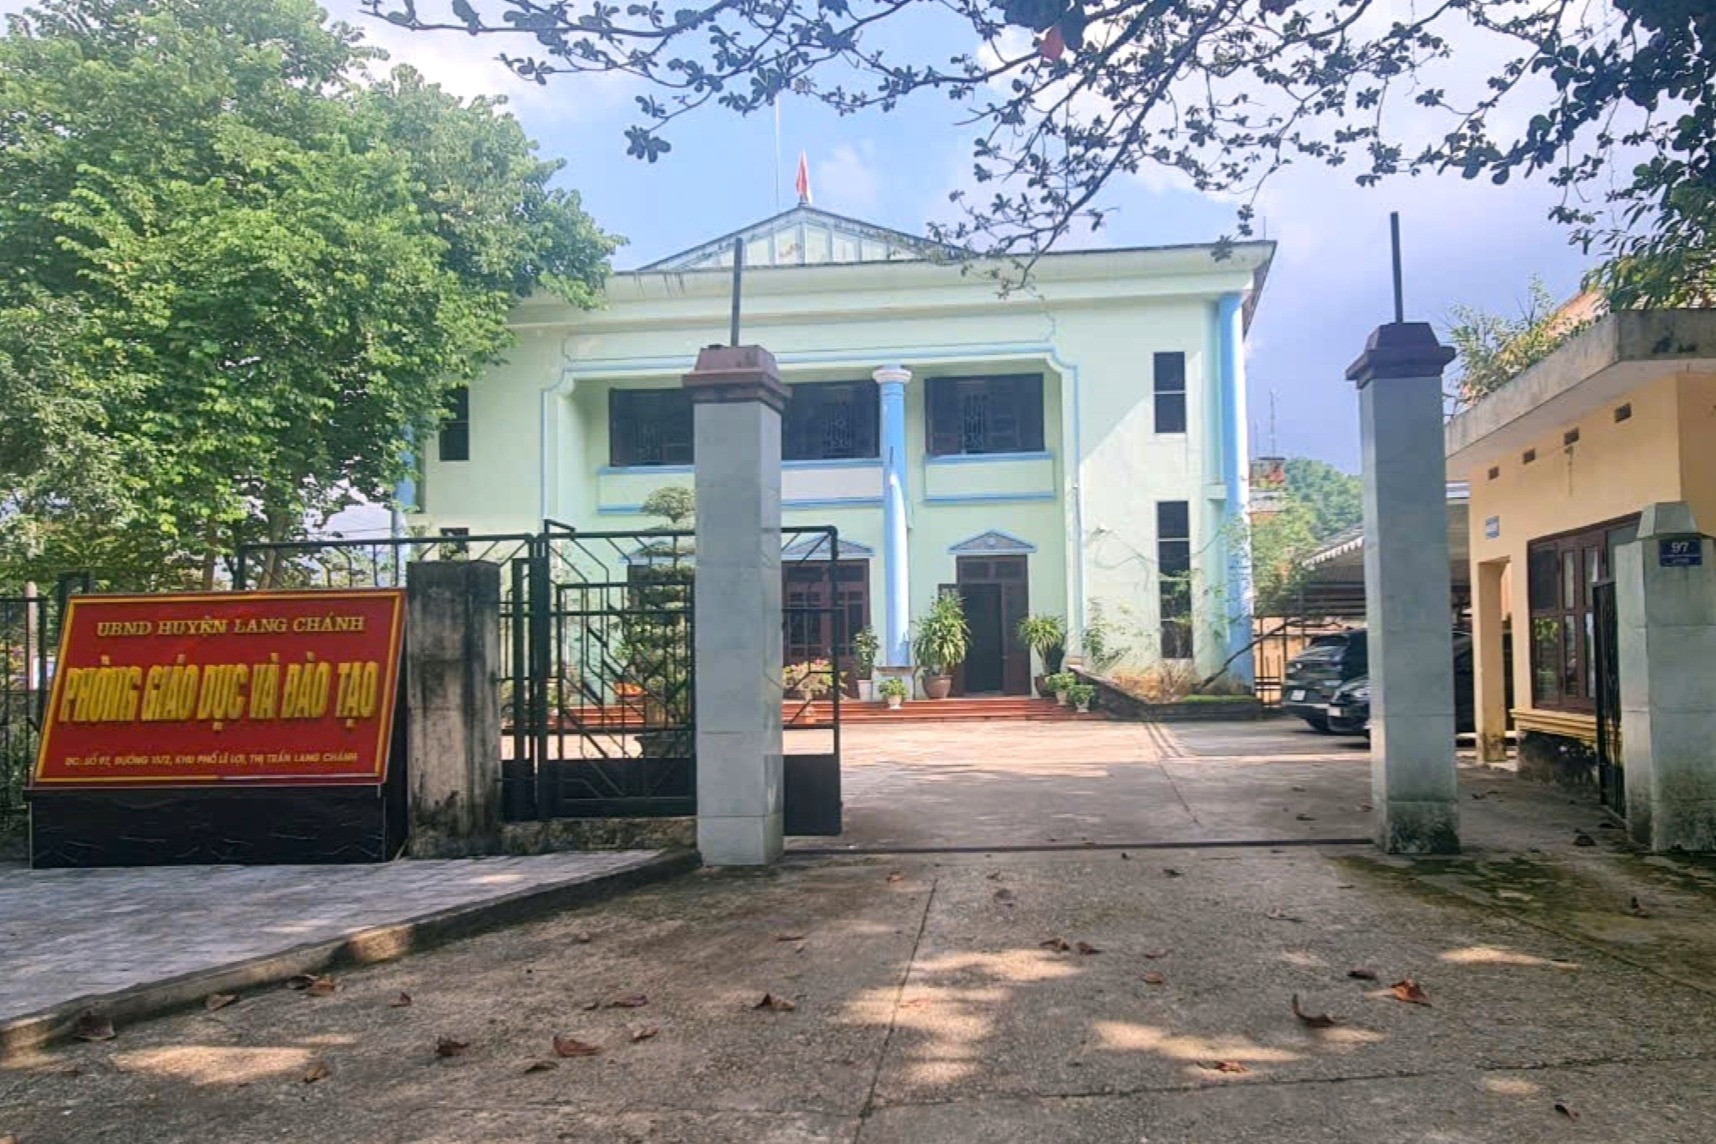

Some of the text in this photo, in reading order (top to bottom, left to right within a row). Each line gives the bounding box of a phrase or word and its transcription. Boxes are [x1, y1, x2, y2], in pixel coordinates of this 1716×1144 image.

[1671, 542, 1689, 554] 97
[97, 611, 364, 636] UBND HUYỆN LANG CHÁNH
[58, 651, 380, 732] PHÒNG GIÁO DỤC VÀ ĐÀO TẠO
[294, 753, 320, 762] LANG
